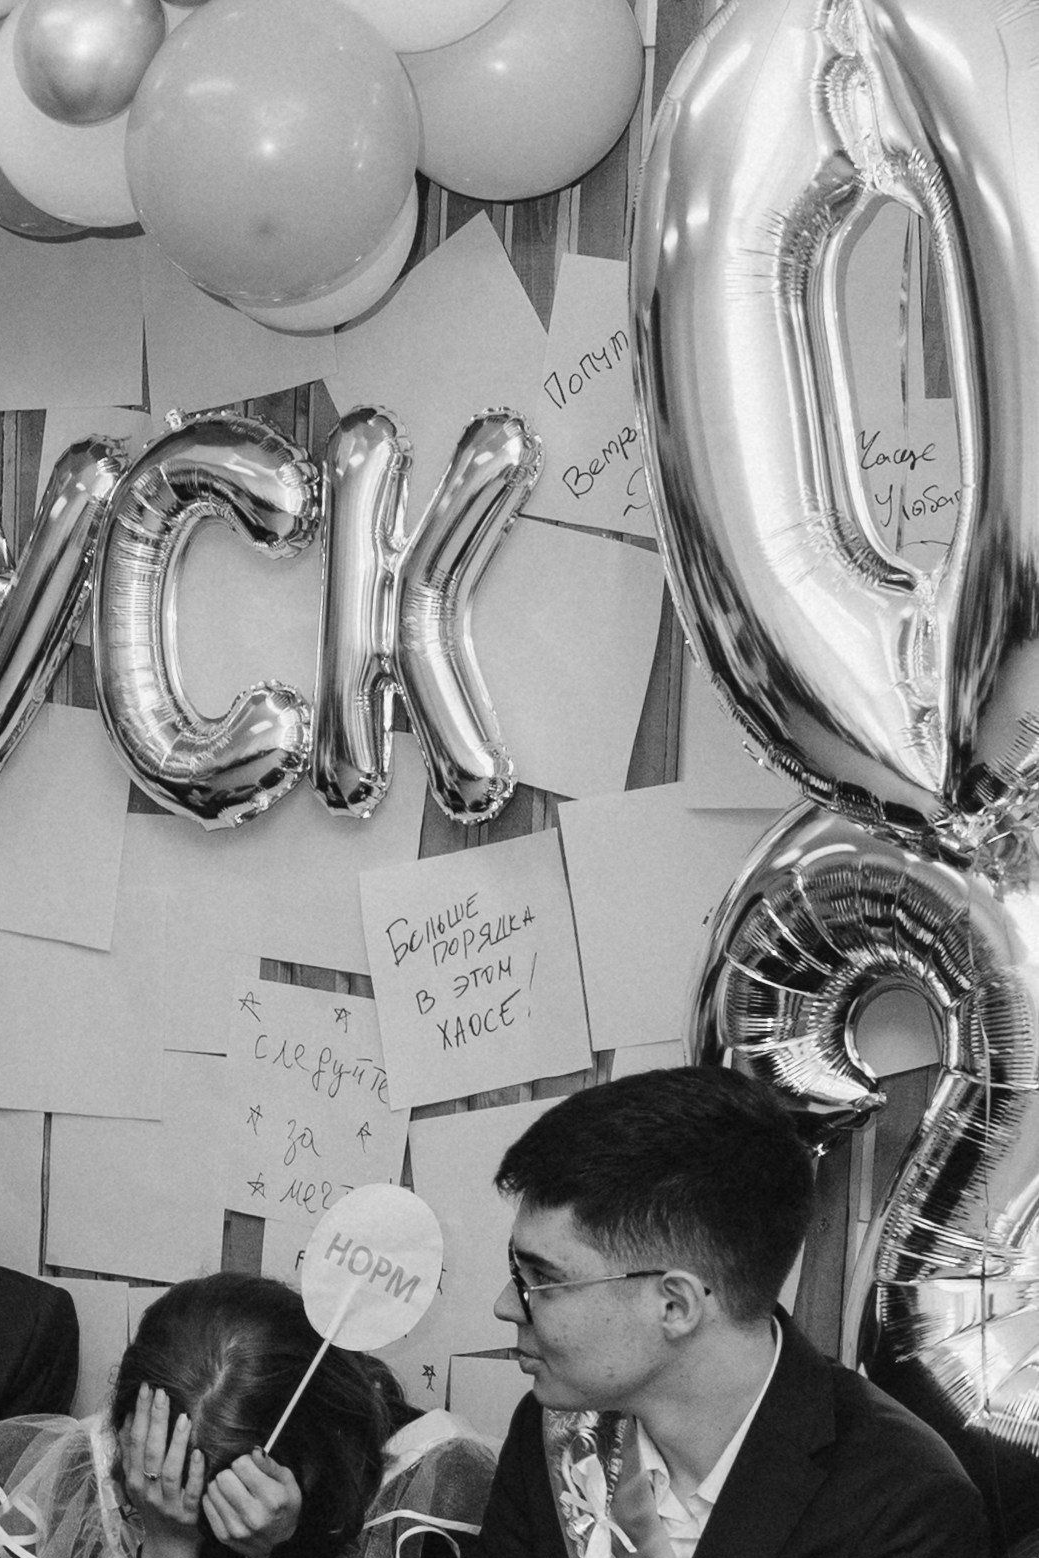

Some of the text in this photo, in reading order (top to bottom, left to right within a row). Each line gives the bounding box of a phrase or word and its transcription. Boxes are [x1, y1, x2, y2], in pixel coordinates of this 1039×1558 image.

[543, 330, 630, 410] Попут
[415, 956, 512, 1015] В ЭТОМ
[324, 1231, 422, 1304] НОРМ
